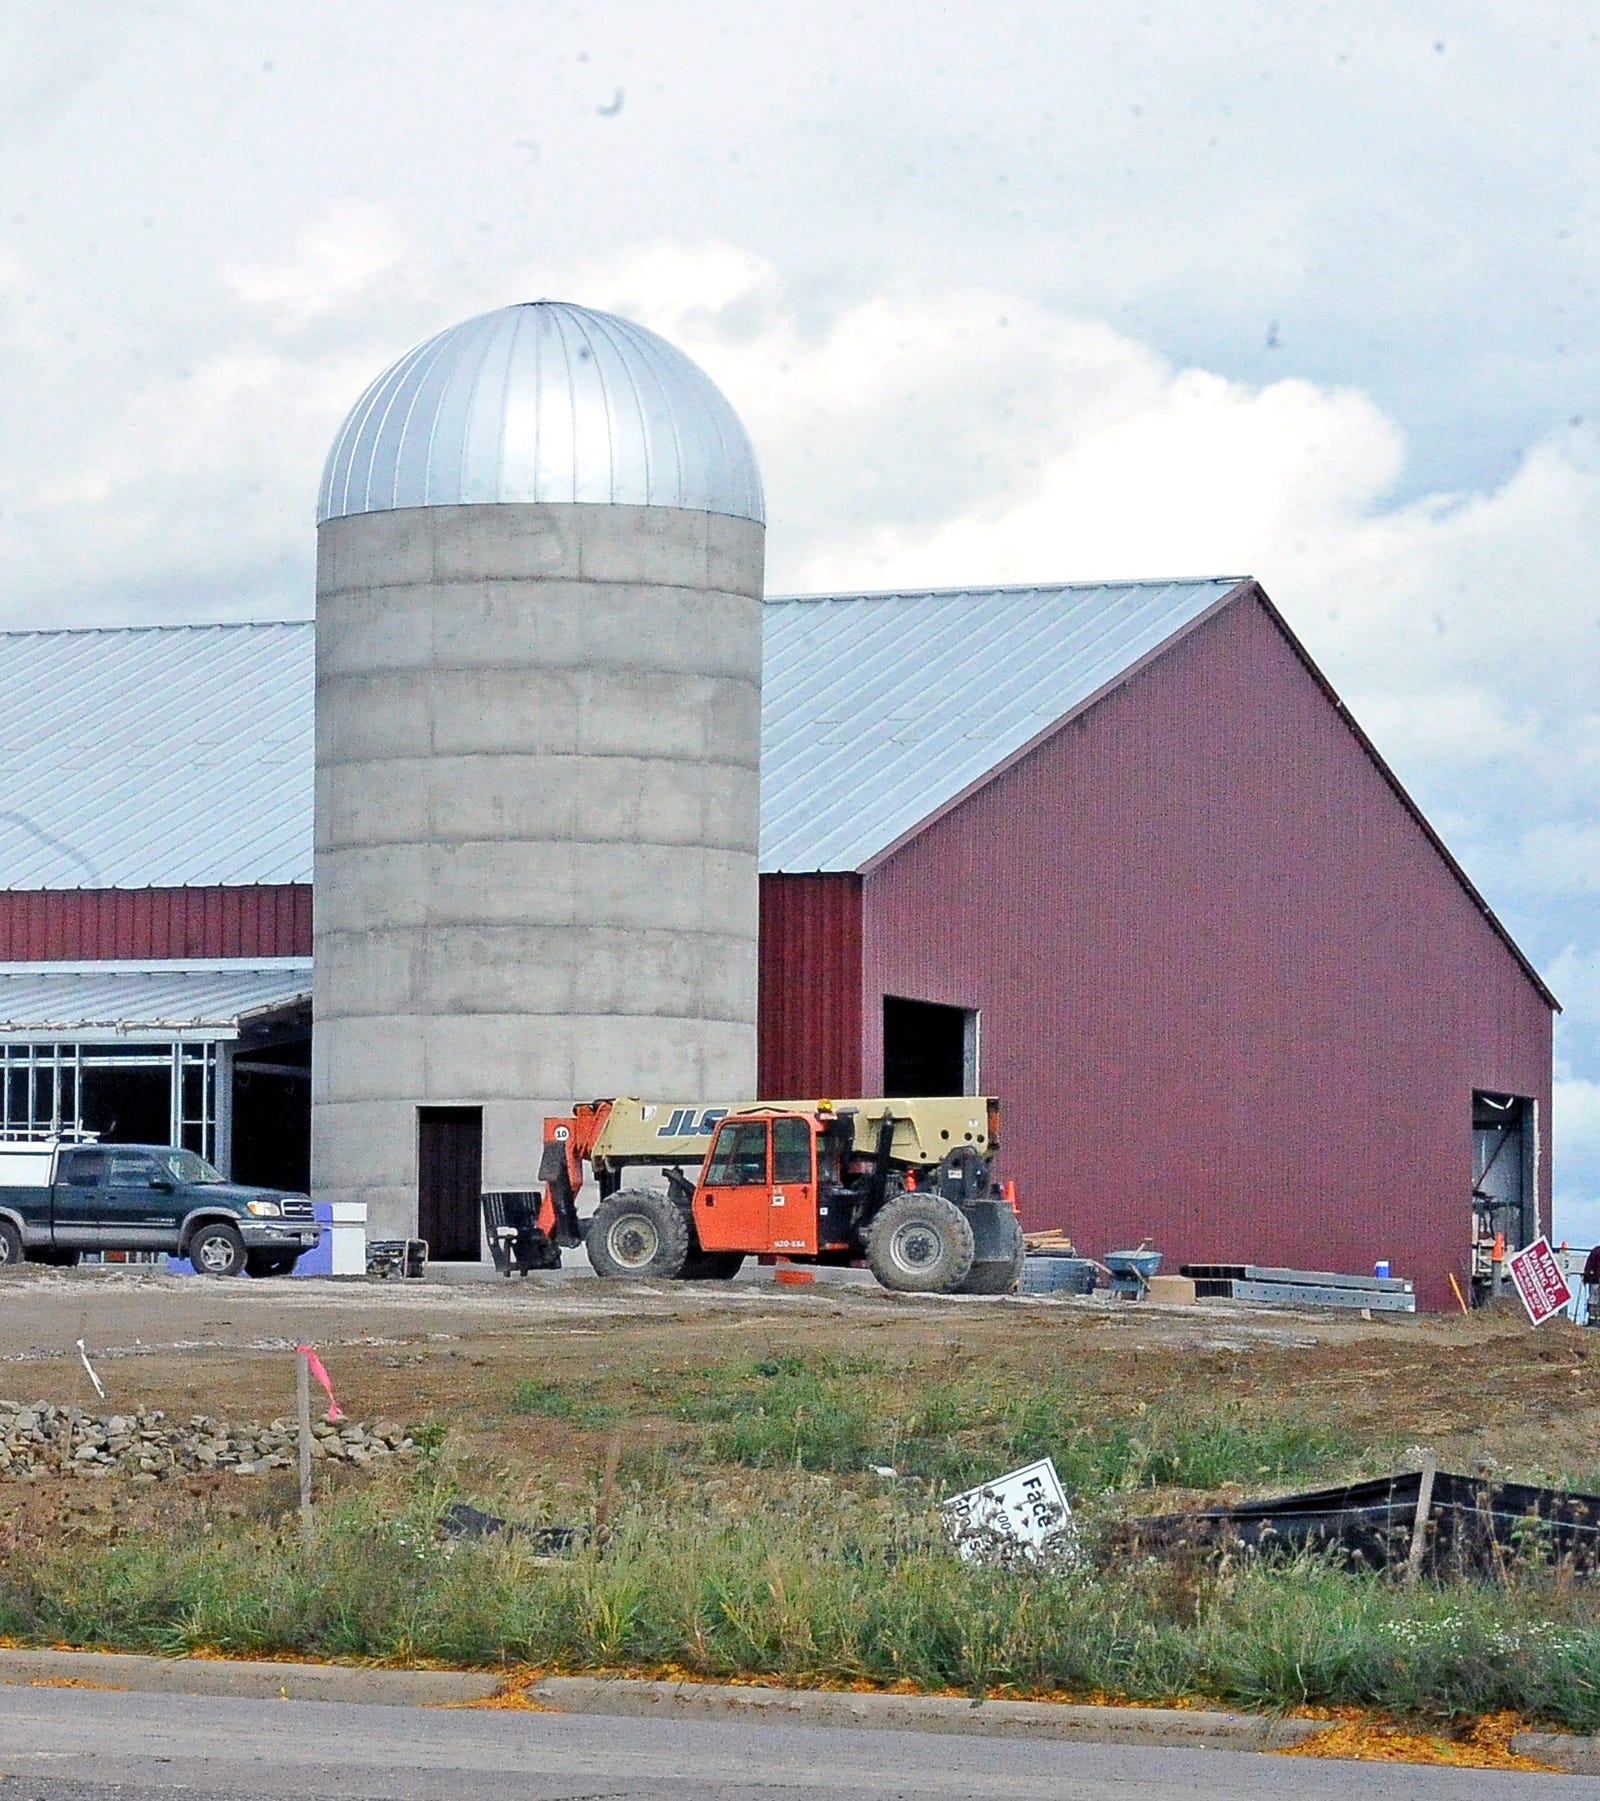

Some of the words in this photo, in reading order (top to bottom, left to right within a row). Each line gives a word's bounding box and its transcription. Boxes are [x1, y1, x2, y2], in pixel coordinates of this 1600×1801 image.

[556, 1130, 567, 1139] 10
[1529, 1250, 1549, 1287] PAVING
[1540, 1252, 1564, 1290] MOST
[1022, 1476, 1051, 1528] Face
